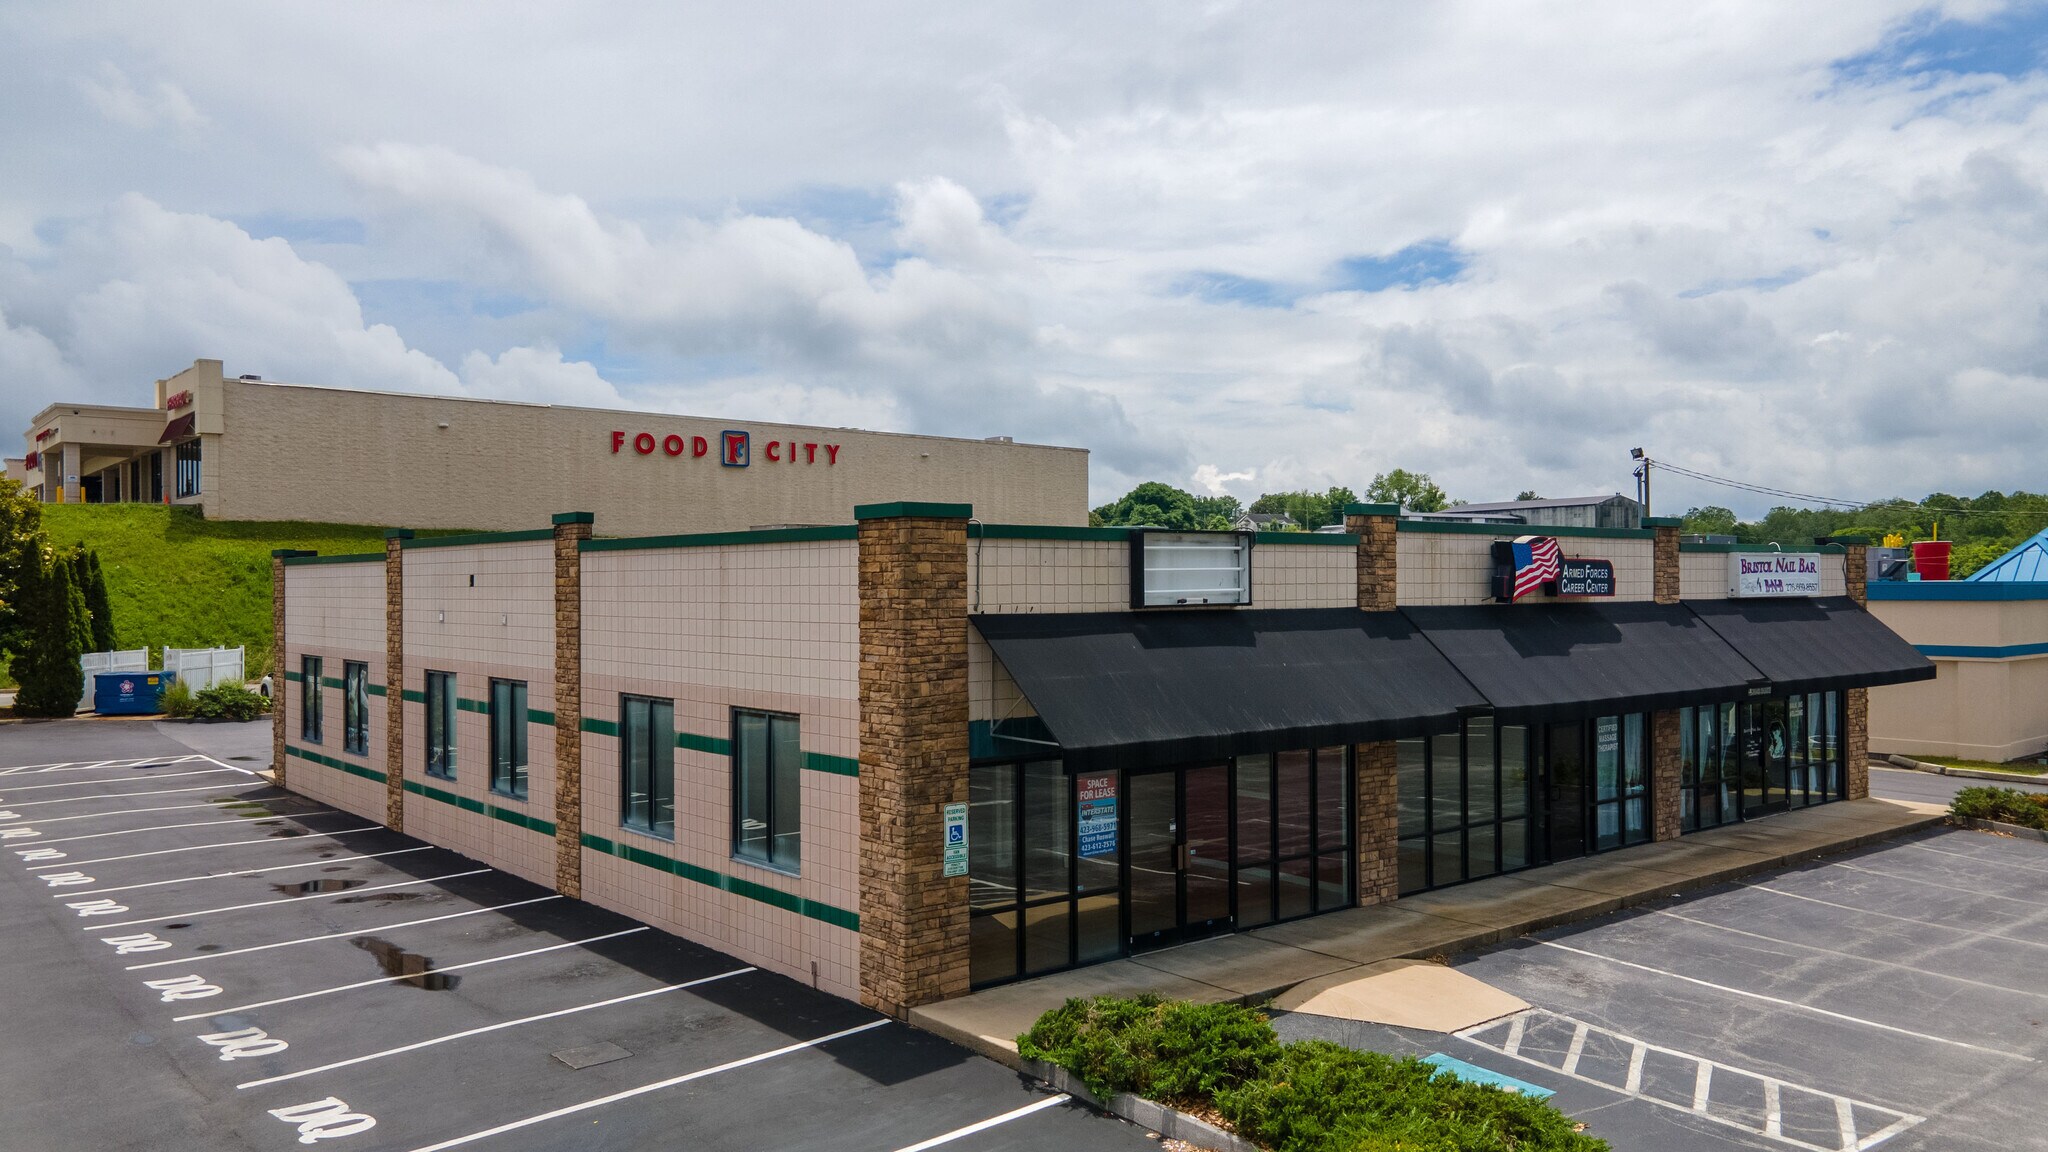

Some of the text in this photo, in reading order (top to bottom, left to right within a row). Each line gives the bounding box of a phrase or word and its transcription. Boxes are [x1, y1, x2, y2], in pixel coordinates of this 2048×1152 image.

[611, 431, 708, 457] FOOD
[765, 440, 840, 464] CITY
[1562, 564, 1608, 578] ARMED FORCES
[1740, 557, 1817, 575] BRISTOL NAIL BAR
[1561, 579, 1608, 593] CAREER CENTER
[1598, 724, 1618, 733] CERTIFIED
[1599, 733, 1617, 742] MASSAGE
[1598, 742, 1618, 752] THERAPIST
[1087, 778, 1108, 789] SPACE
[1080, 787, 1115, 800] FOR LEASE
[1081, 806, 1114, 816] INTERSTATE
[197, 1026, 289, 1061] DQ
[267, 1096, 377, 1144] DQ
